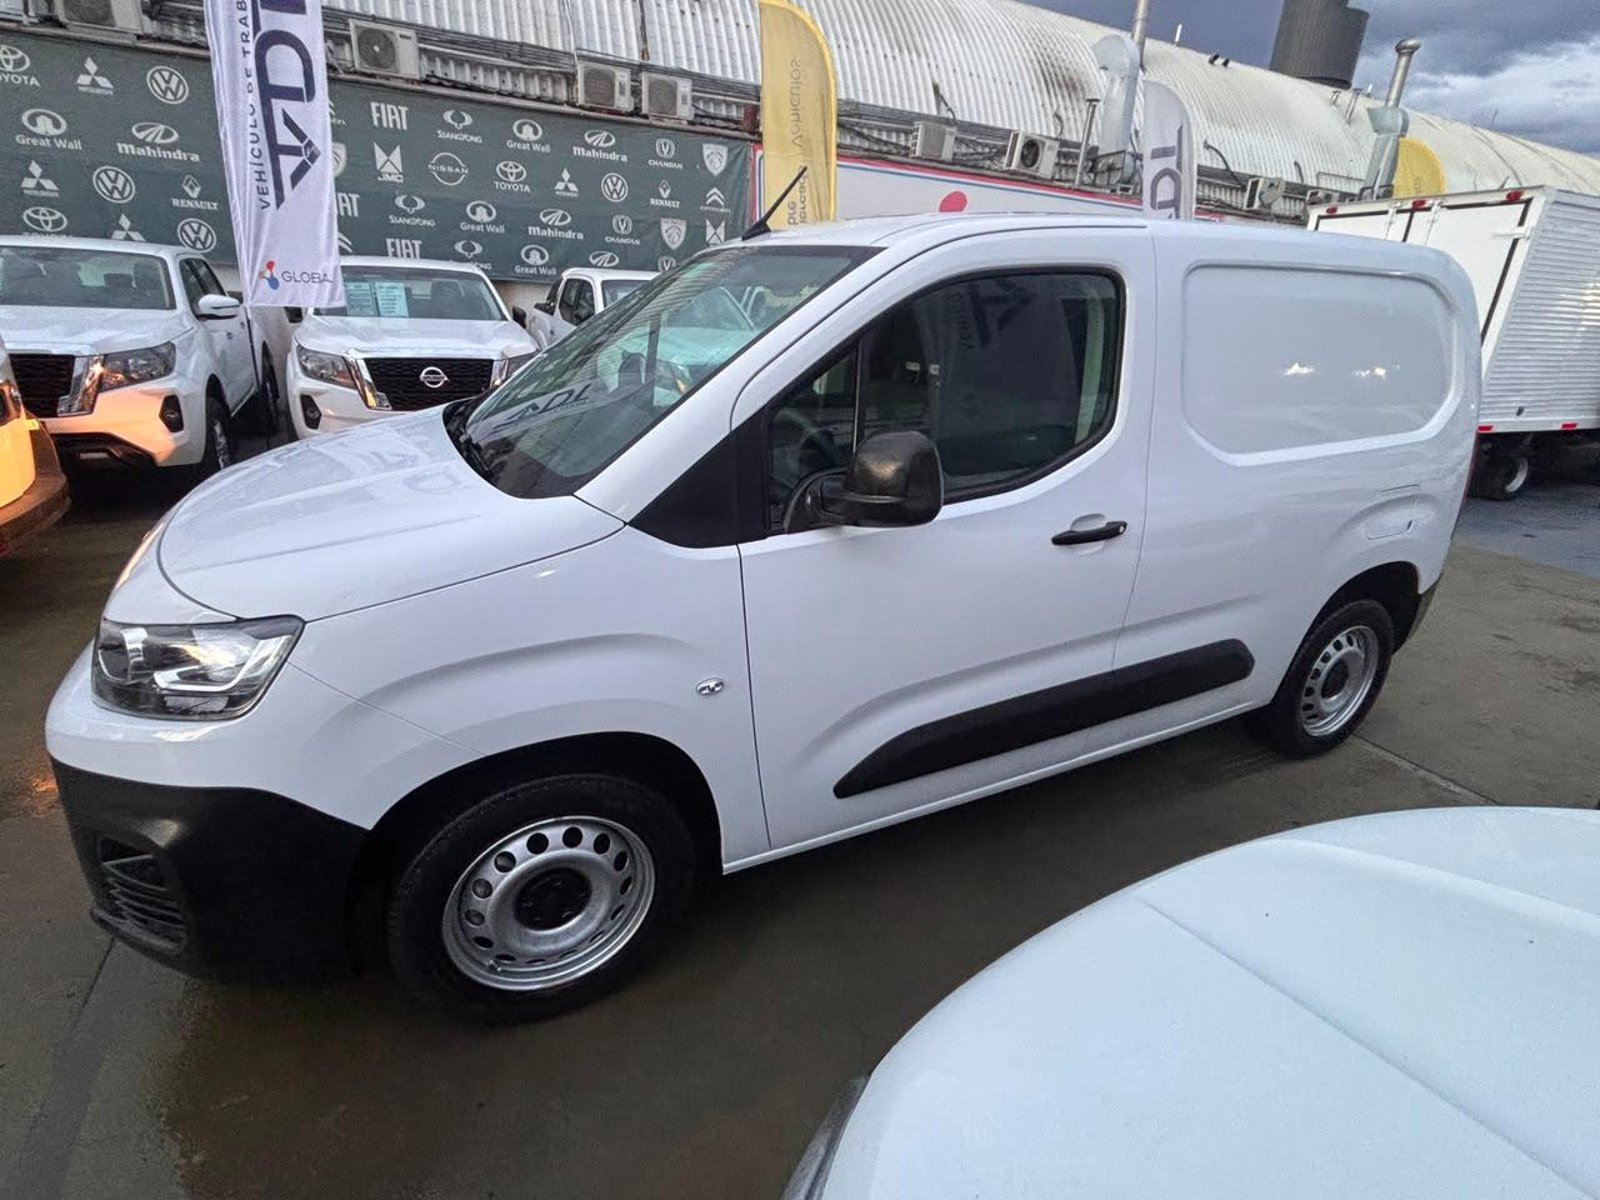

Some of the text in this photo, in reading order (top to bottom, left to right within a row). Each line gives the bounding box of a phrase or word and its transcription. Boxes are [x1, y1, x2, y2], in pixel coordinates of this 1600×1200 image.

[0, 73, 41, 88] YOTA
[370, 101, 409, 131] FIAT
[16, 134, 82, 150] Great Wall
[506, 139, 551, 153] Great Wall
[116, 142, 200, 162] Mahindra
[572, 145, 628, 162] Mahindra
[427, 163, 469, 174] NISSAN
[378, 174, 405, 184] JMC
[493, 180, 531, 193] TOYOTA
[171, 198, 220, 211] RENAULT
[337, 191, 361, 218] AT
[459, 221, 505, 234] Great Wall
[528, 225, 584, 240] Mahindra
[385, 237, 423, 260] FIAT
[281, 270, 334, 284] GLOBA
[514, 264, 557, 277] Great Wall
